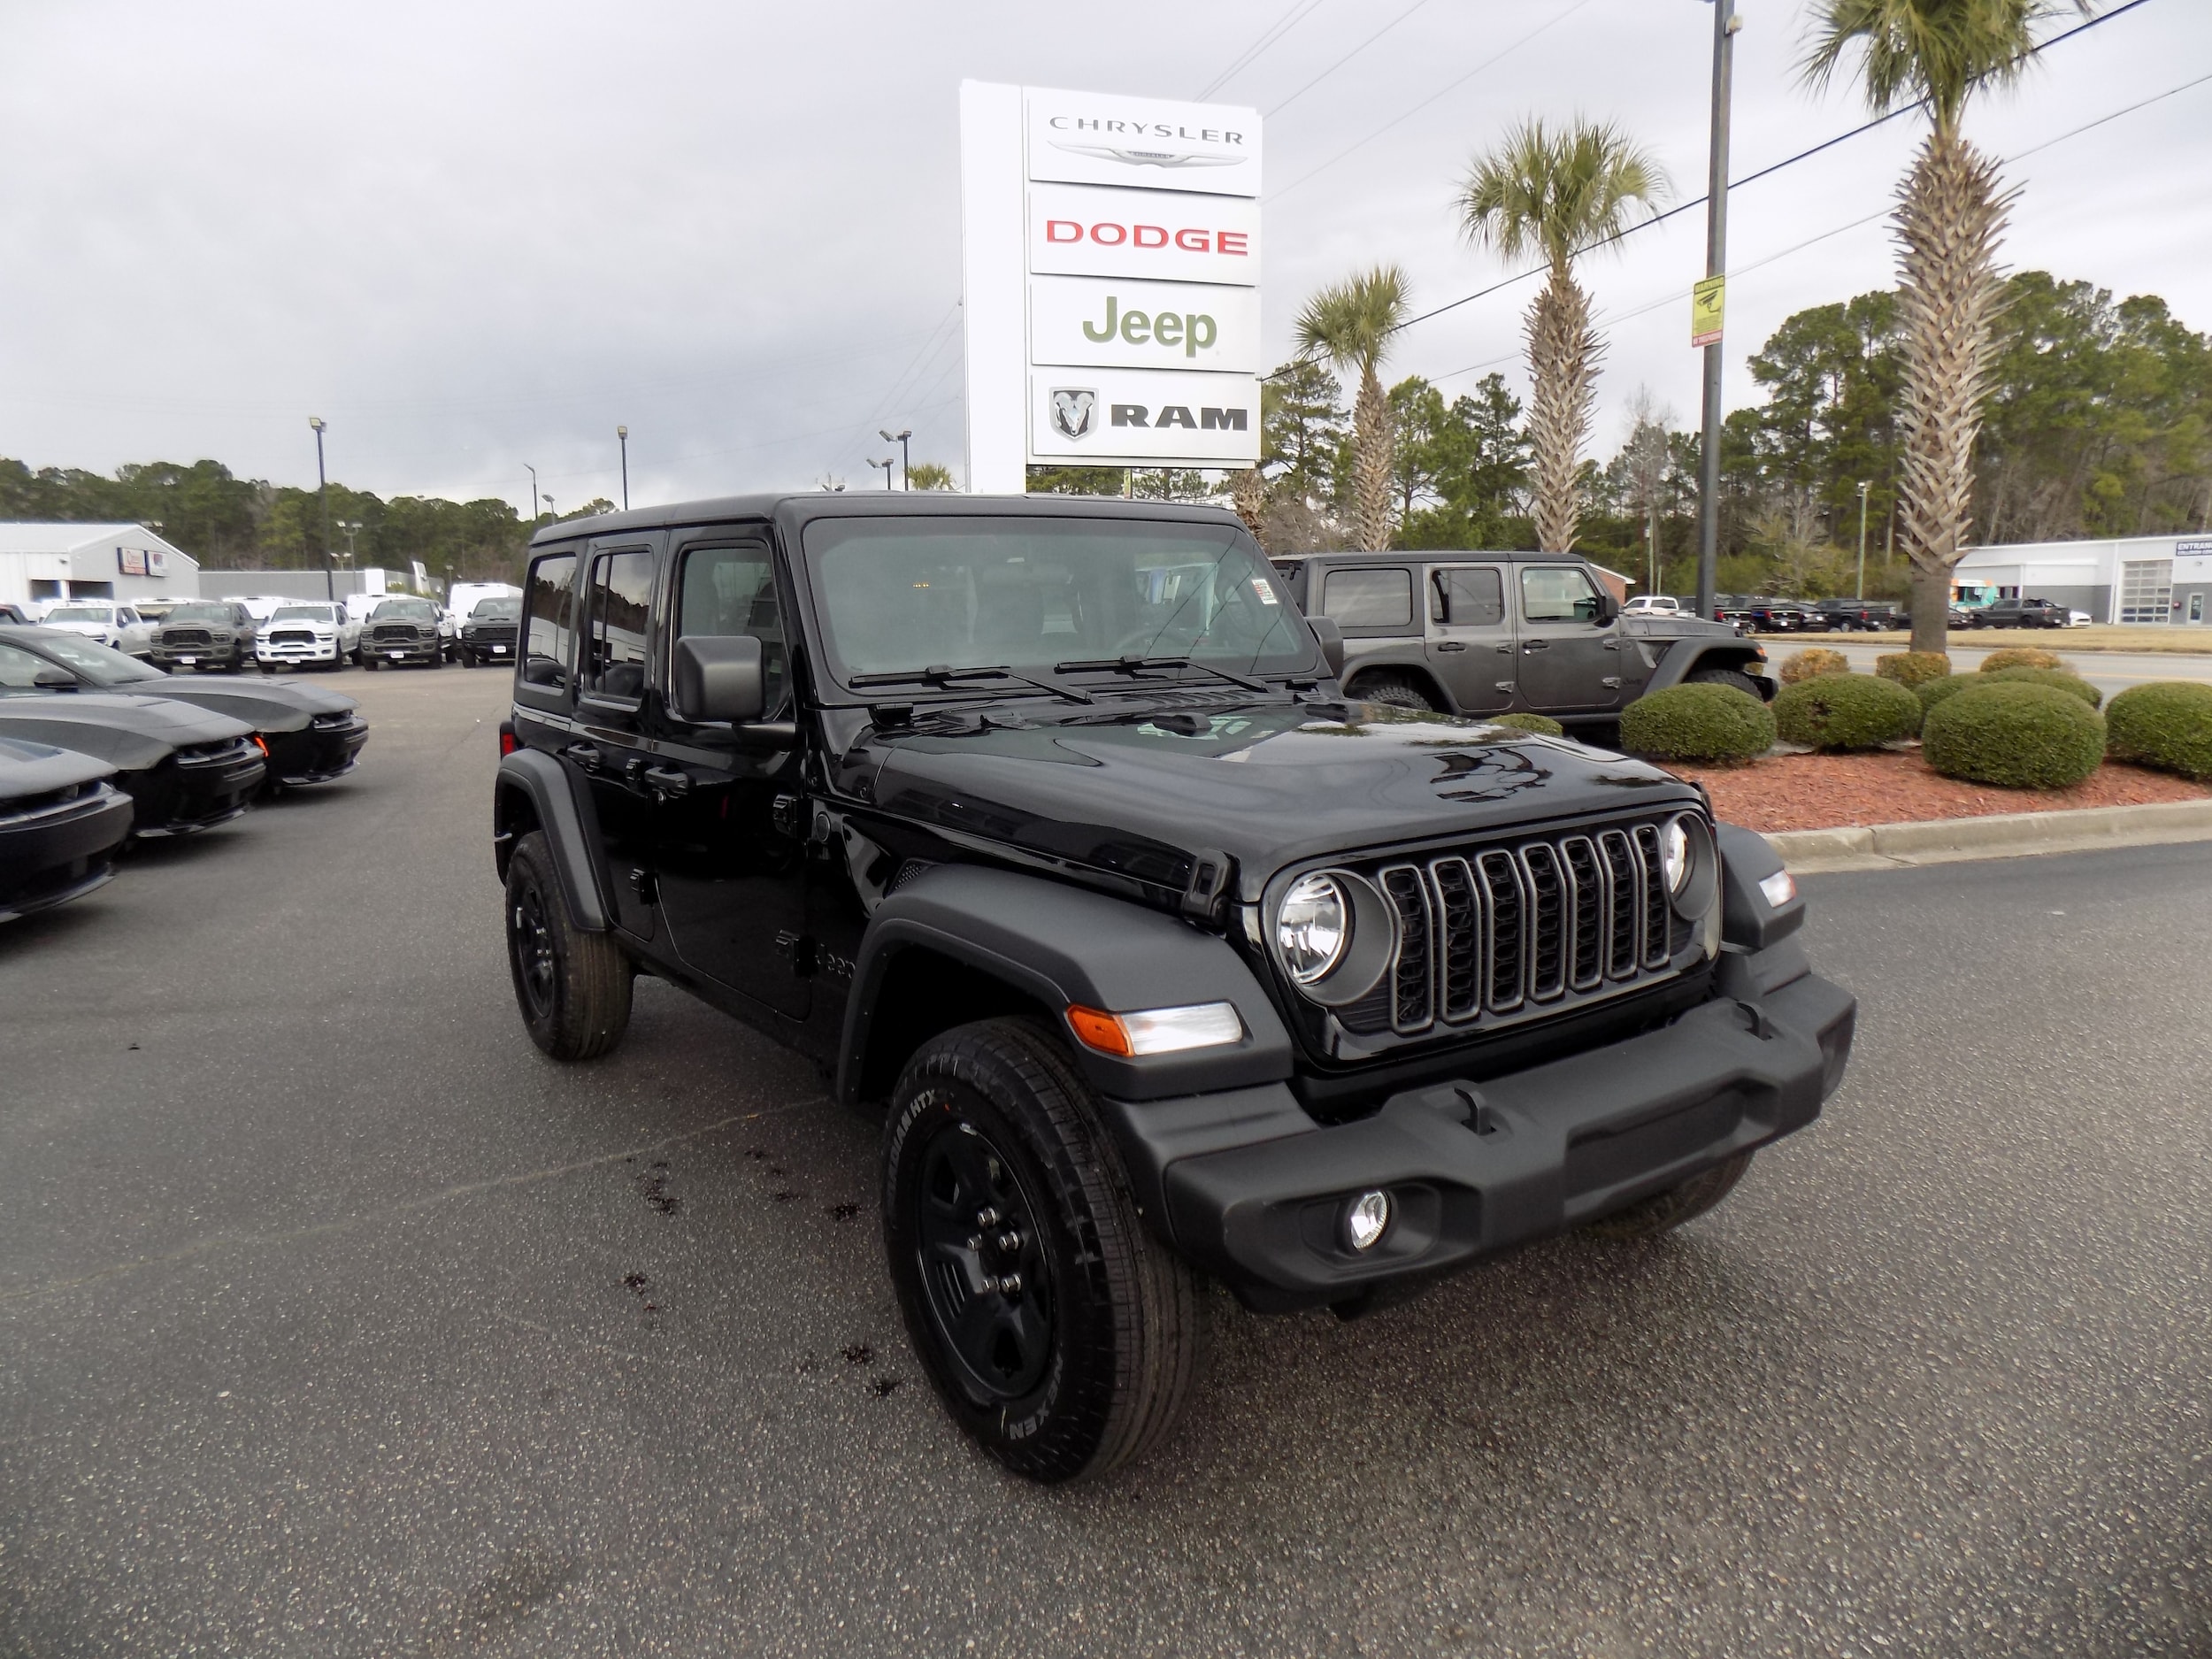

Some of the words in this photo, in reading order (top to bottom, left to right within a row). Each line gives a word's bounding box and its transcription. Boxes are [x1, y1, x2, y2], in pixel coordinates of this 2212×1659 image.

[1049, 117, 1243, 145] CHRYSLER
[1046, 219, 1248, 257] DODGE
[1082, 296, 1217, 357] Jeep
[1110, 403, 1248, 432] RAM
[910, 1088, 937, 1118] HTX
[1009, 1351, 1064, 1440] NEXEN
